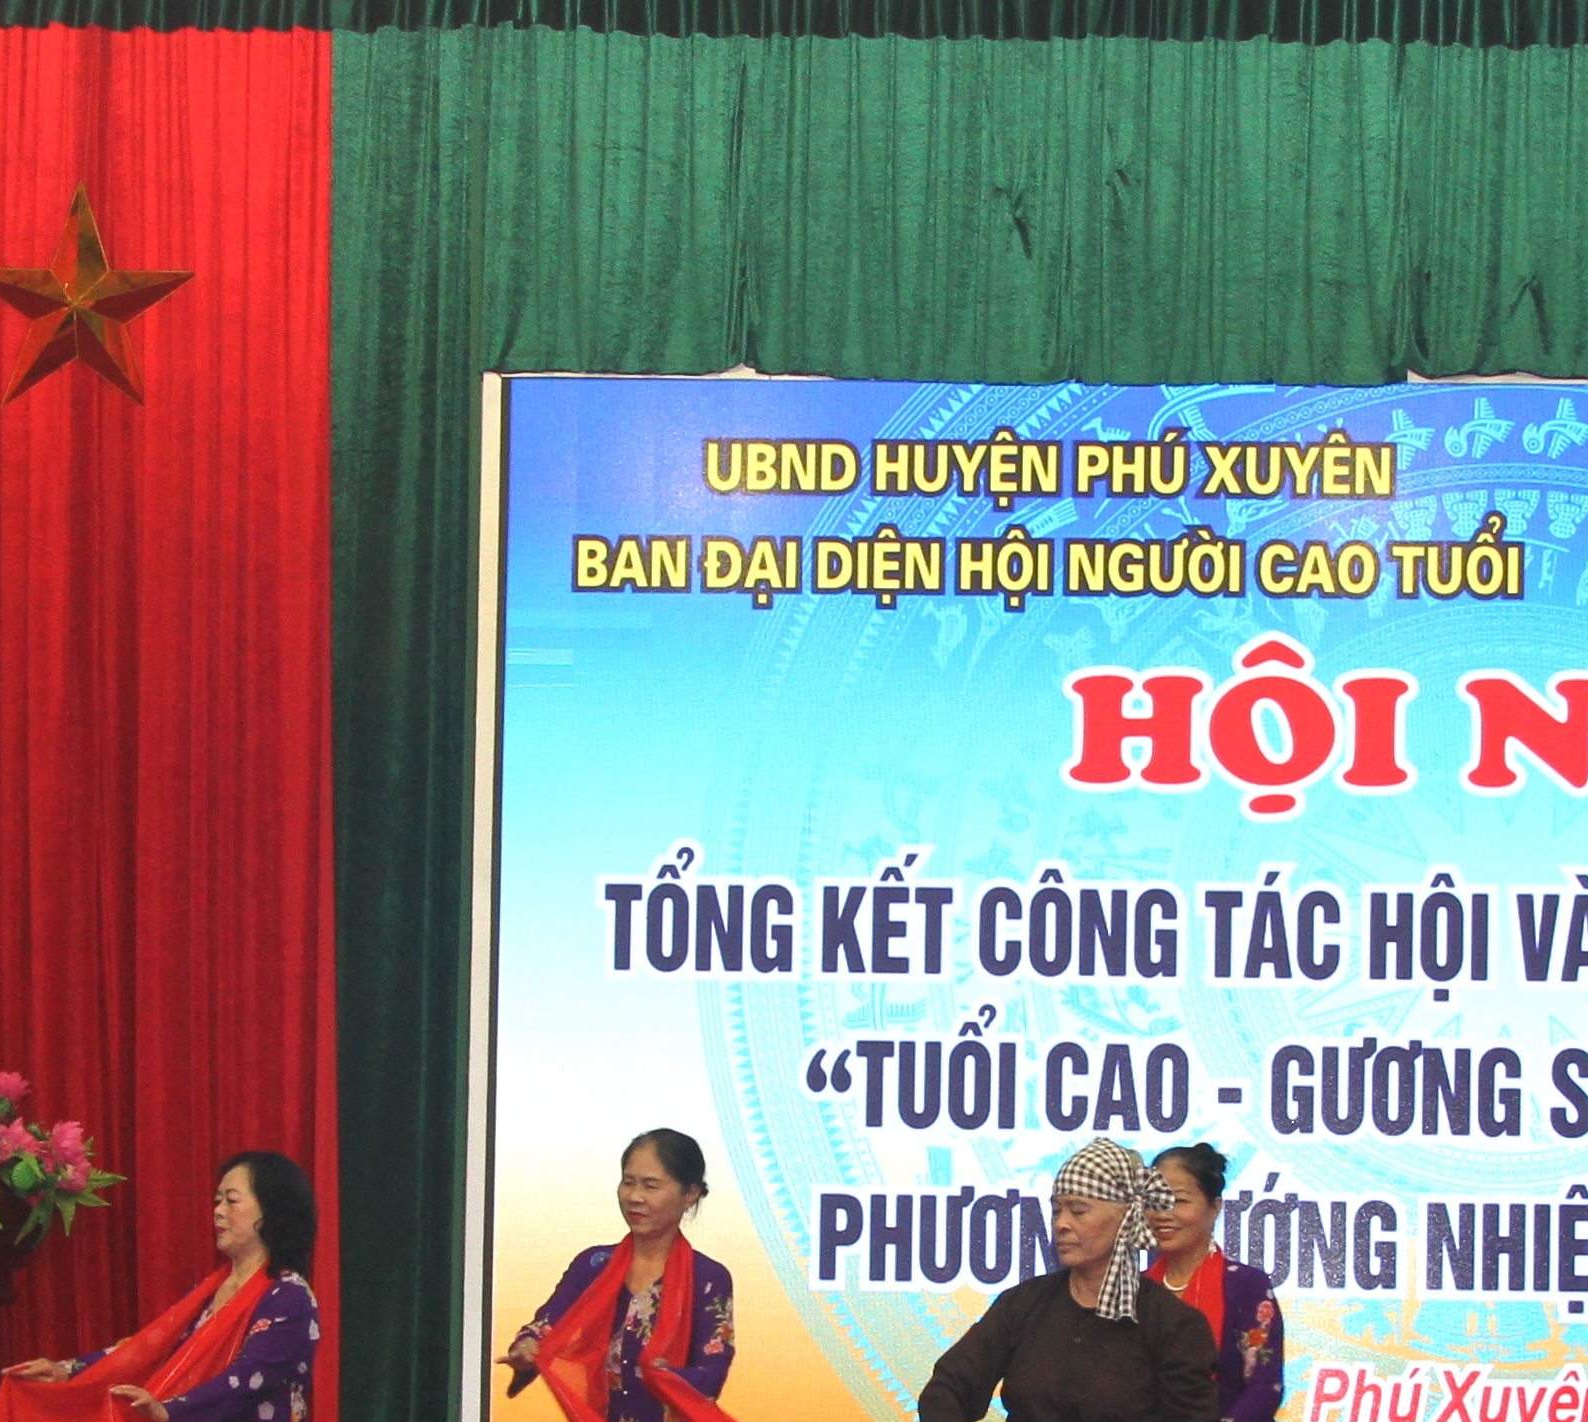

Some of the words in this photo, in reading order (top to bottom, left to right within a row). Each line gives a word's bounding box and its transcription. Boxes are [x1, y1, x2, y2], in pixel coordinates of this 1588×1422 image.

[705, 443, 859, 493] UBND
[875, 435, 1059, 508] HUYỆN
[1074, 431, 1189, 494] PHÚ
[1202, 433, 1395, 496] XUYÊN
[576, 538, 687, 589] BAN
[703, 538, 797, 605] ĐẠI
[815, 529, 942, 606] DIỆN
[958, 530, 1052, 608] HỘI
[1068, 526, 1243, 594] NGƯỜI
[1257, 539, 1378, 594] CAO
[1391, 515, 1522, 596] TUỔI
[1068, 639, 1410, 814] HỘI
[604, 846, 794, 974] TỔNG
[820, 853, 953, 975] KẾT
[977, 868, 1179, 977] CÔNG
[1204, 871, 1342, 979] TÁC
[1369, 874, 1492, 1001] HỘI
[806, 1003, 1015, 1131] “TUỔI
[1044, 1042, 1191, 1133] CAO
[1271, 1036, 1522, 1137] GƯƠNG
[818, 1186, 1053, 1284] PHƯƠN
